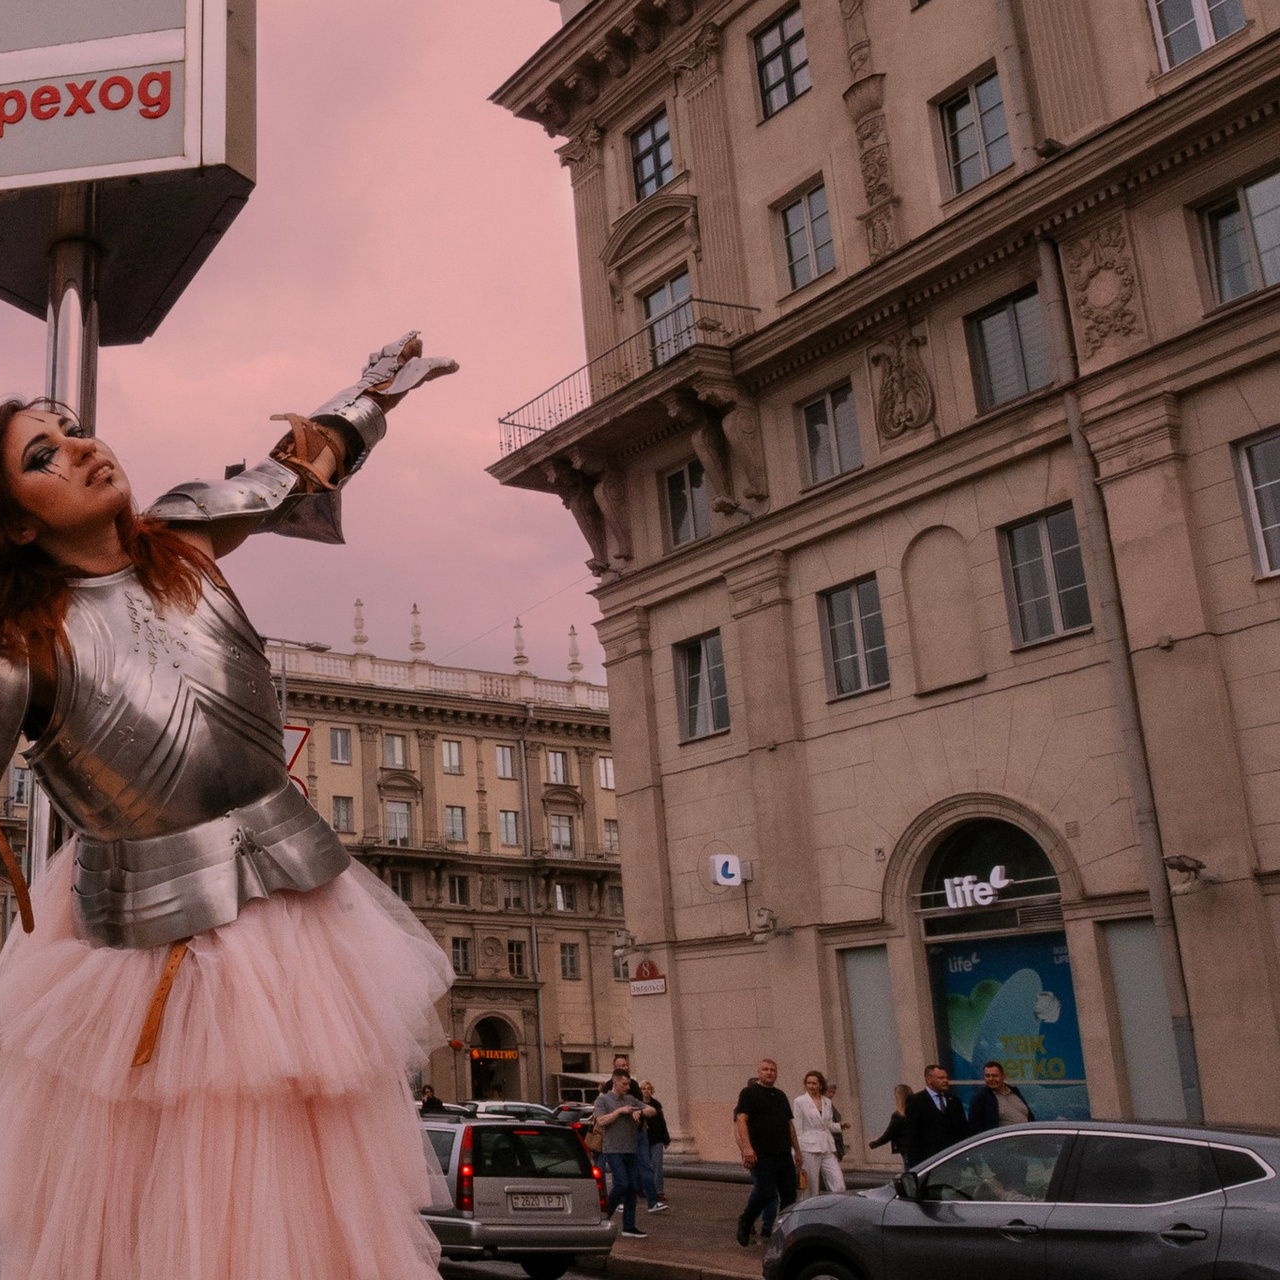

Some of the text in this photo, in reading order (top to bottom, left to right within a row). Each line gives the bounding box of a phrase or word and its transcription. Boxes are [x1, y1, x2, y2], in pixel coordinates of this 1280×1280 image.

[942, 874, 998, 909] life
[642, 961, 650, 978] 8
[999, 1034, 1048, 1055] так
[996, 1057, 1067, 1080] егко
